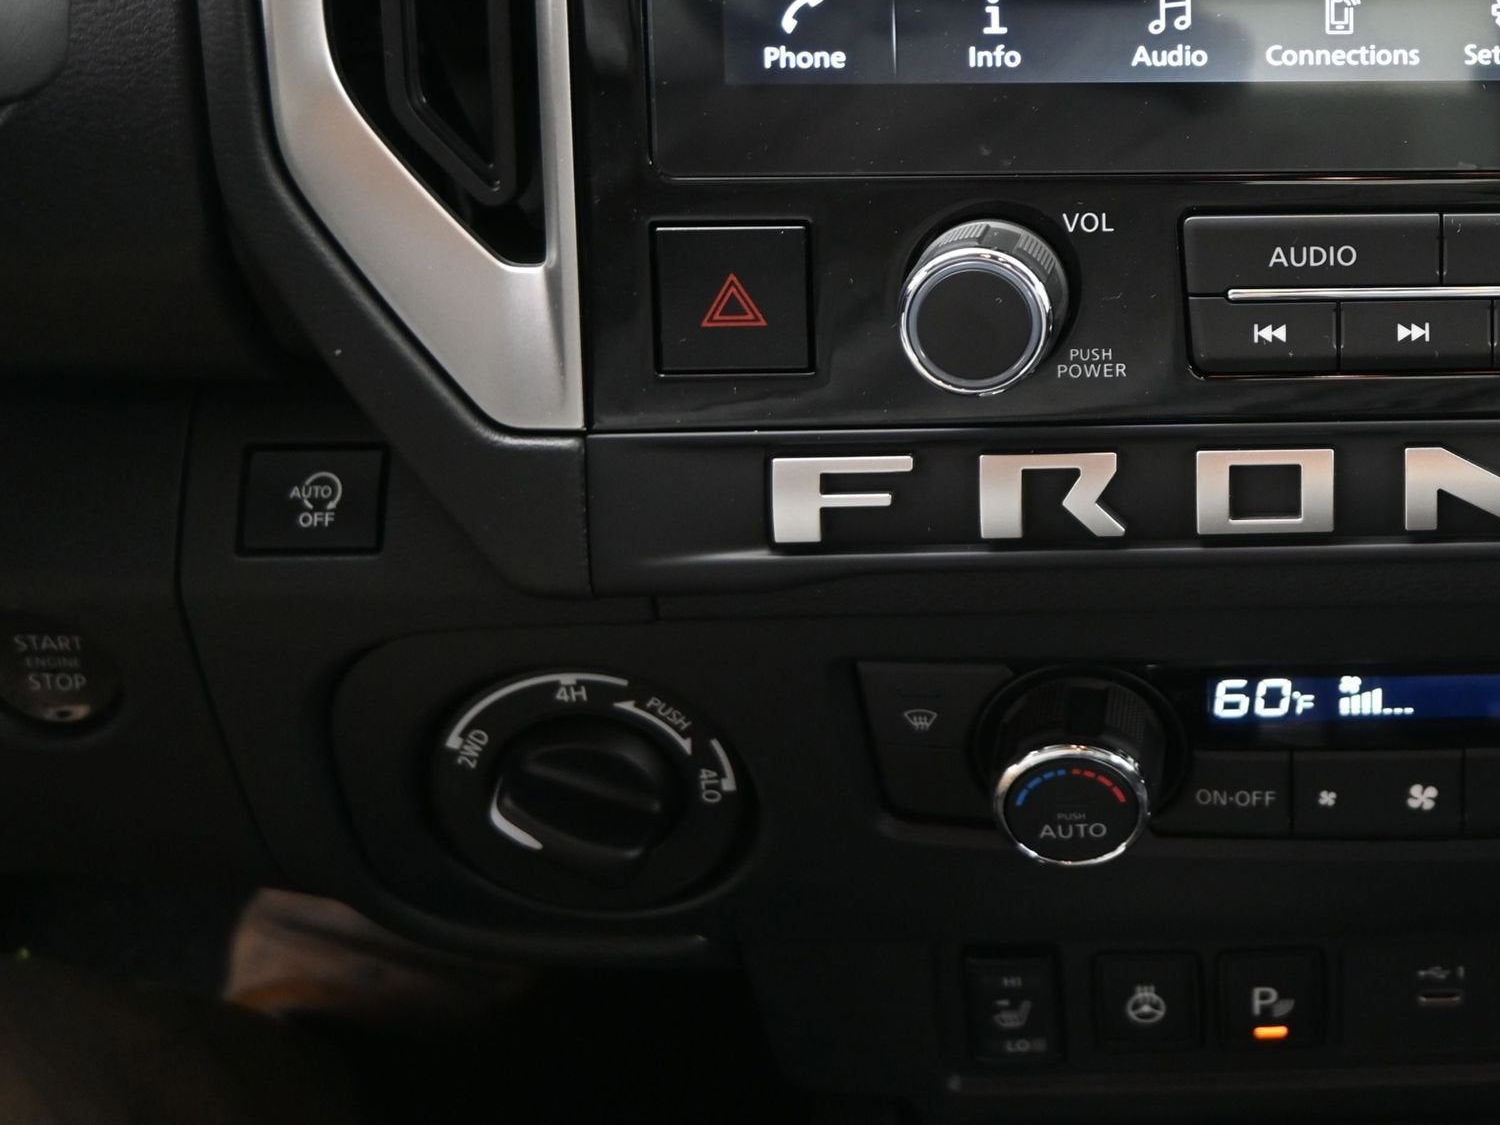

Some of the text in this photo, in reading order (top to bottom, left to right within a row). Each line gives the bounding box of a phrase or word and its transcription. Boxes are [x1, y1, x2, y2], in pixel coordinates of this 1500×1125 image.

[762, 45, 847, 70] Phone
[968, 45, 1022, 68] Info
[1130, 43, 1209, 68] Audio
[1264, 44, 1420, 67] Connections
[1061, 211, 1116, 234] VOL
[1268, 245, 1358, 268] AUDIO
[1068, 347, 1114, 361] PUSH
[1056, 362, 1128, 379] POWER
[289, 485, 333, 499] AUTO
[298, 512, 336, 527] OFF
[13, 634, 82, 651] START
[28, 672, 87, 691] STOP
[555, 685, 589, 703] 4H
[646, 696, 694, 731] PUSH
[456, 728, 490, 769] 2WD
[698, 767, 723, 805] 4LO
[1056, 812, 1087, 821] PUSH
[1039, 823, 1108, 839] AUTO
[1002, 976, 1023, 988] HI
